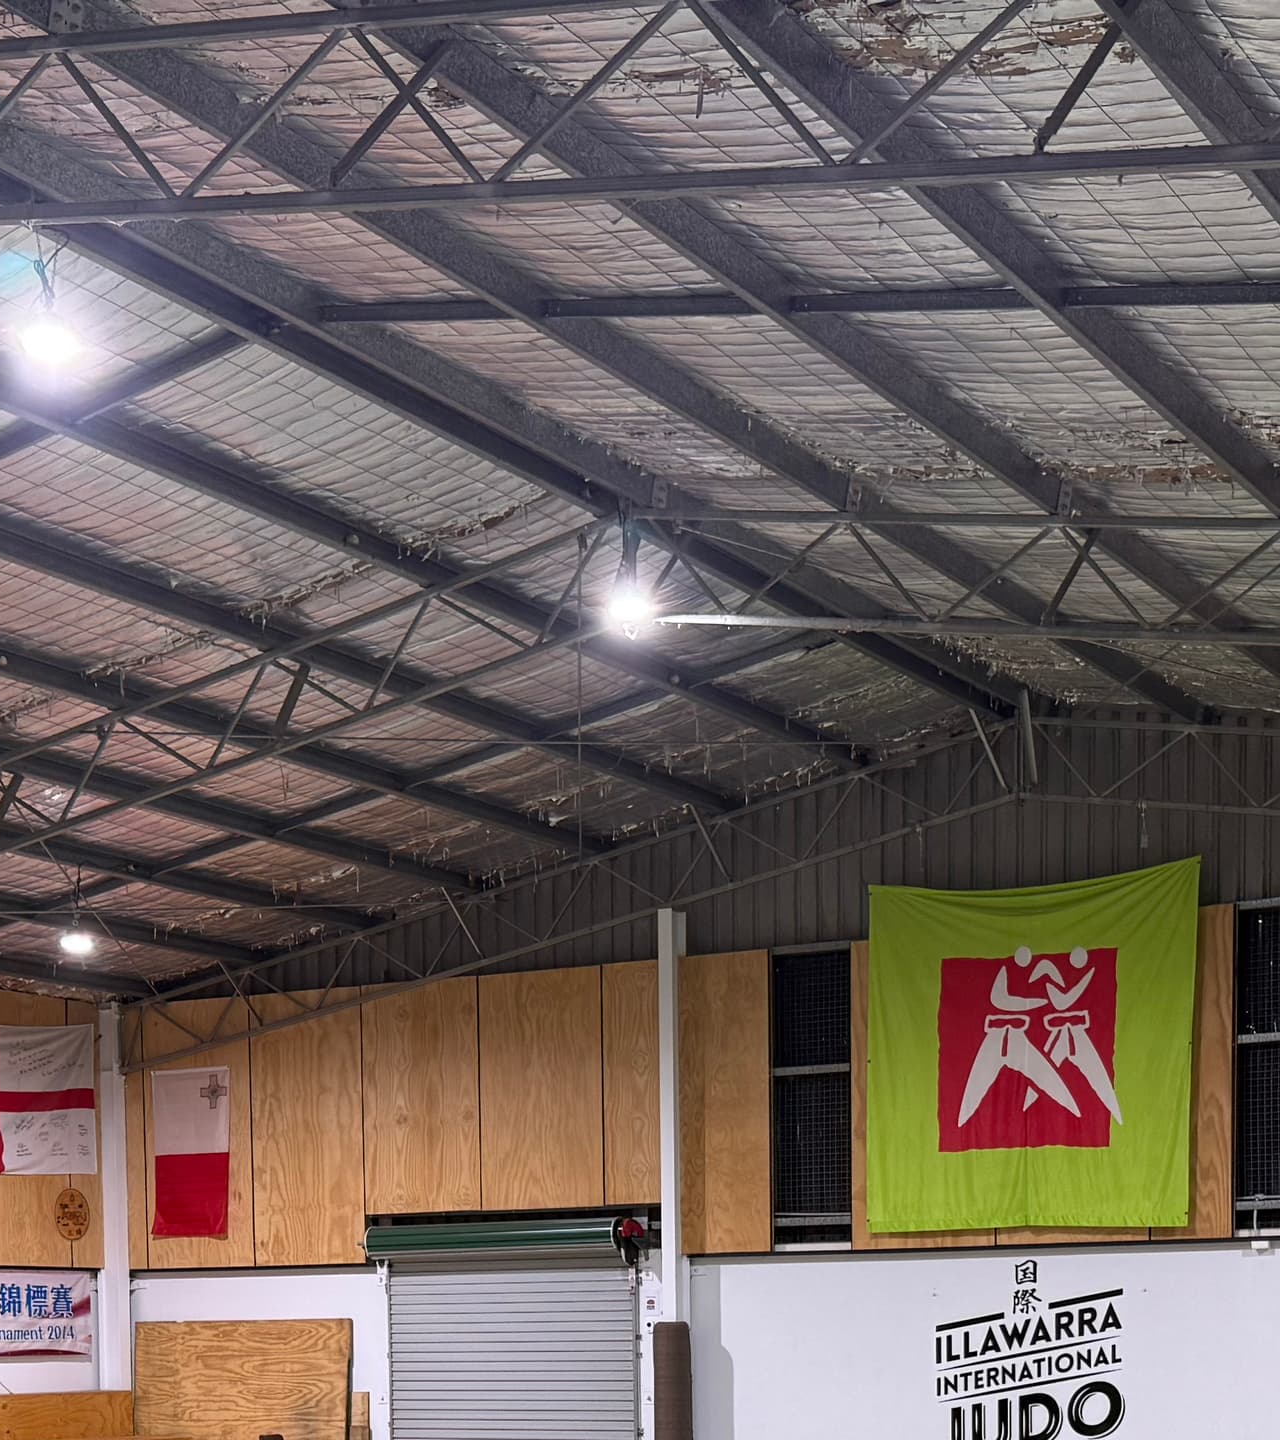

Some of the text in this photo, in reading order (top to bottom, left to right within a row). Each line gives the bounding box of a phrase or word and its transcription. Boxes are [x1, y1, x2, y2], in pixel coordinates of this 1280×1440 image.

[47, 1325, 75, 1340] 2014
[936, 1302, 1122, 1364] ILLAWARRA
[937, 1344, 1122, 1396] INTERNATIONAL
